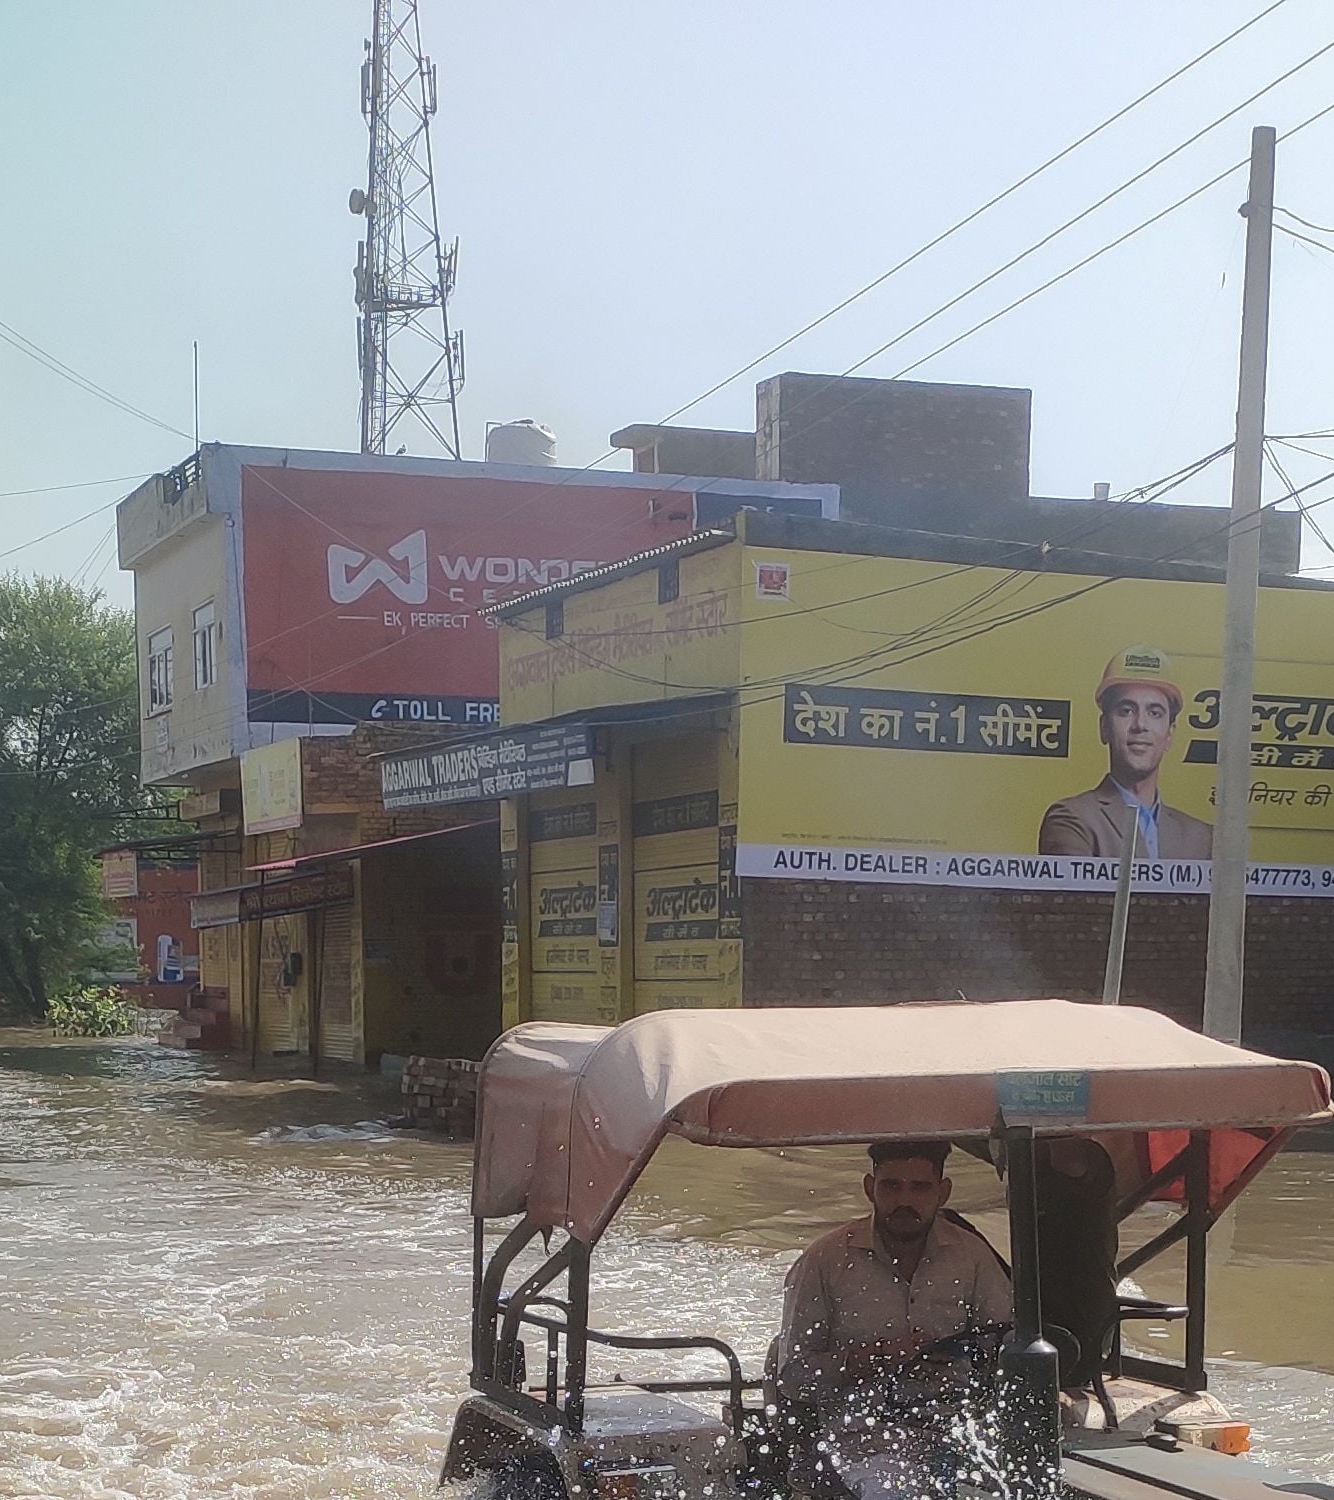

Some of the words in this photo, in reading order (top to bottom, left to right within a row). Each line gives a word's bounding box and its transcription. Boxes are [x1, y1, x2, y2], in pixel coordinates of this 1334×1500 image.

[383, 611, 402, 626] EK
[411, 612, 470, 629] PERFECT
[393, 700, 451, 720] TOLL
[793, 691, 849, 737] देश
[859, 707, 904, 740] का
[914, 701, 967, 744] नं.1
[978, 703, 1062, 749] सीमेंट
[381, 758, 432, 793] AGGARWAL
[431, 748, 479, 784] TRADERS
[1304, 784, 1333, 809] की
[773, 850, 837, 871] AUTH.
[844, 853, 928, 875] DEALER
[946, 857, 1065, 880] AGGARWAL
[1169, 864, 1203, 887] (M.)
[539, 880, 597, 918] अल्ट्राटेक
[646, 877, 717, 920] अल्ट्राटेक
